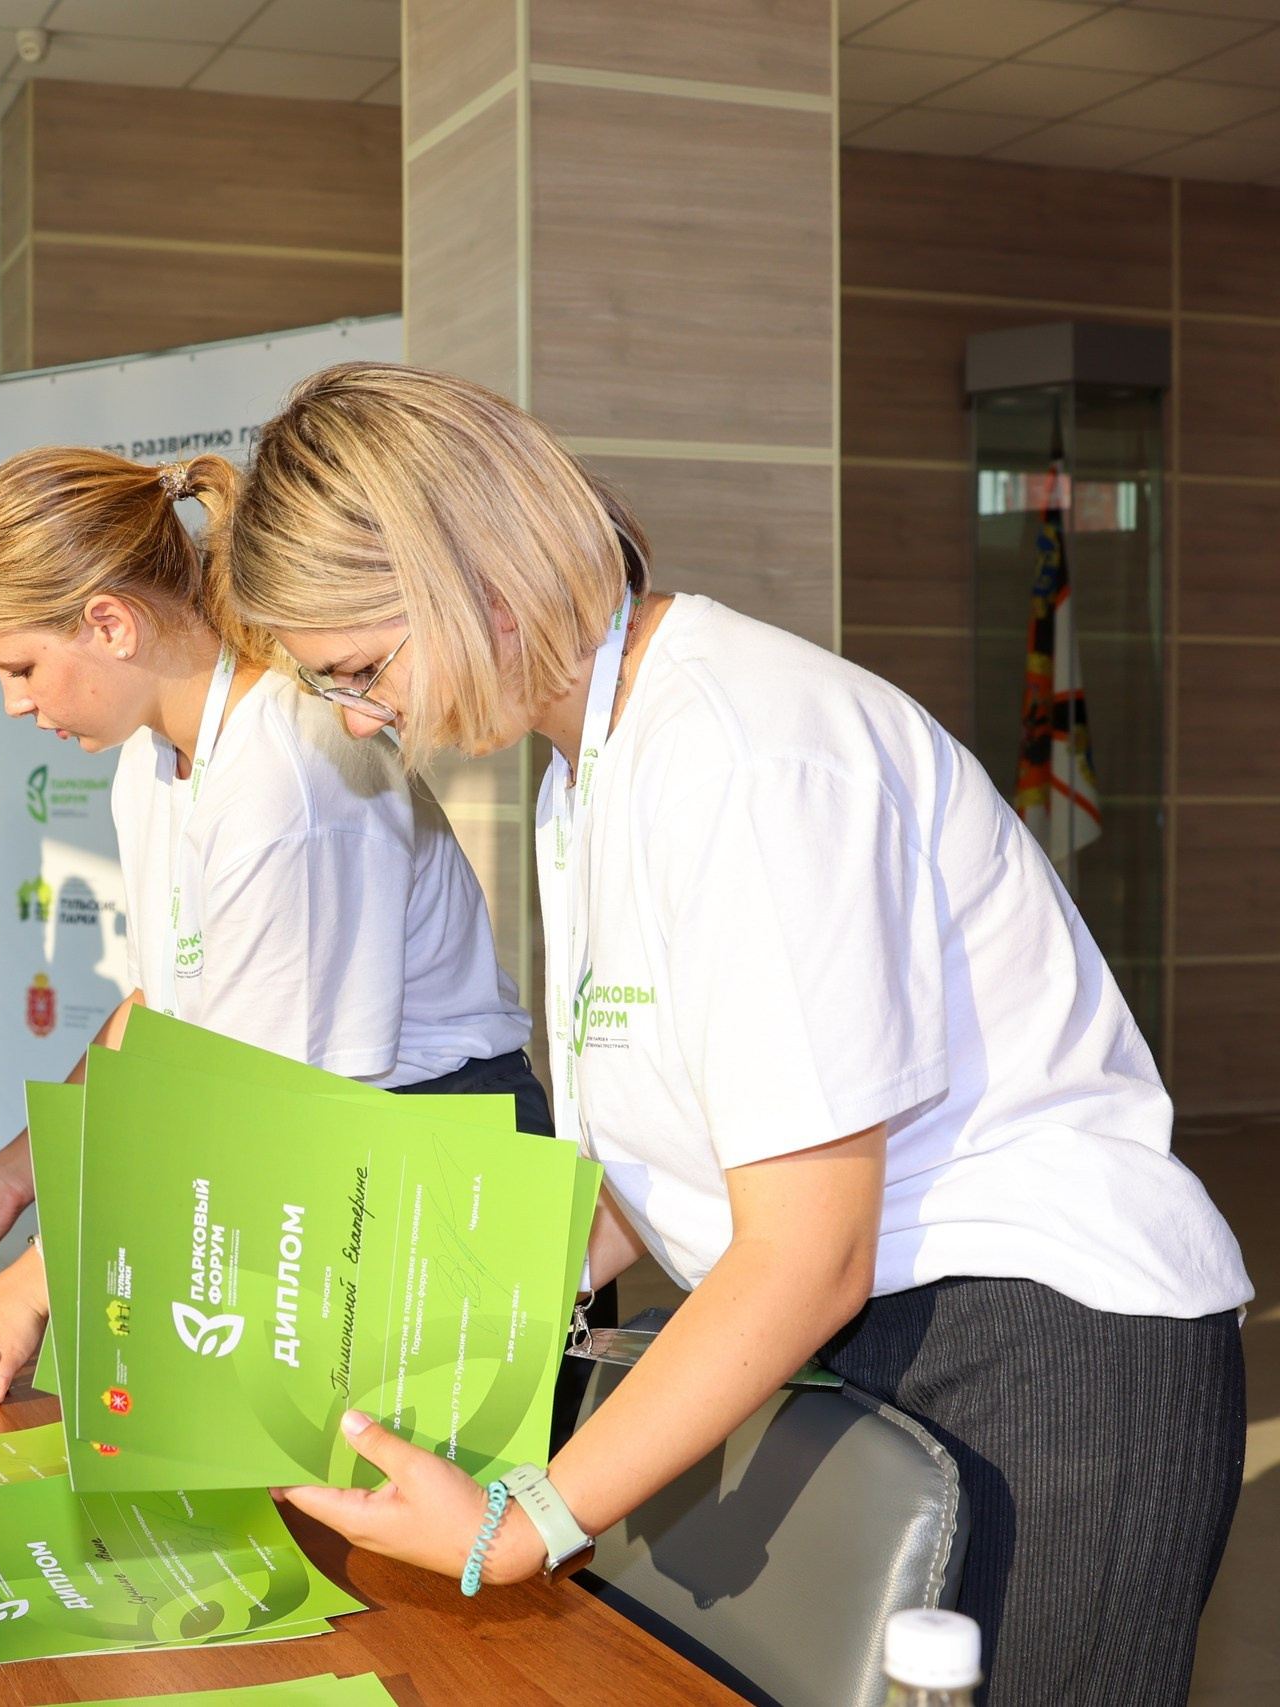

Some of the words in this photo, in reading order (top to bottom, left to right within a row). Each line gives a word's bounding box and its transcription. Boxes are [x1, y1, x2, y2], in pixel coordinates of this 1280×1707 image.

[132, 428, 232, 458] развитию
[582, 762, 594, 806] ПАРКОВЫЙ
[60, 913, 98, 926] ПАРКИ
[590, 985, 656, 1004] АРКОВЫ
[589, 1010, 628, 1028] ОРУМ
[342, 1167, 375, 1264] Екатерине
[410, 1184, 422, 1245] проведении
[468, 1194, 480, 1231] Черных
[191, 1178, 210, 1301] ПАРКОВЫЙ
[118, 1247, 126, 1297] ТУЛЬСКИЕ
[124, 1265, 132, 1299] ПАРКИ
[208, 1224, 225, 1305] ФОРУМ
[274, 1203, 305, 1368] ДИПЛОМ
[404, 1256, 416, 1315] подготовке
[417, 1258, 428, 1298] форума
[321, 1266, 332, 1319] вручается
[330, 1277, 357, 1399] Тимониной
[399, 1325, 409, 1366] участие
[411, 1300, 424, 1355] Паркового
[509, 1309, 518, 1339] августа
[454, 1333, 467, 1381] «Тульские
[507, 1340, 515, 1362] 29-30
[395, 1366, 405, 1416] активное
[451, 1397, 459, 1410] ГУ
[452, 1382, 462, 1396] ТО
[393, 1417, 400, 1430] за
[447, 1412, 459, 1460] Директор
[26, 1541, 94, 1609] ДИПЛОМ
